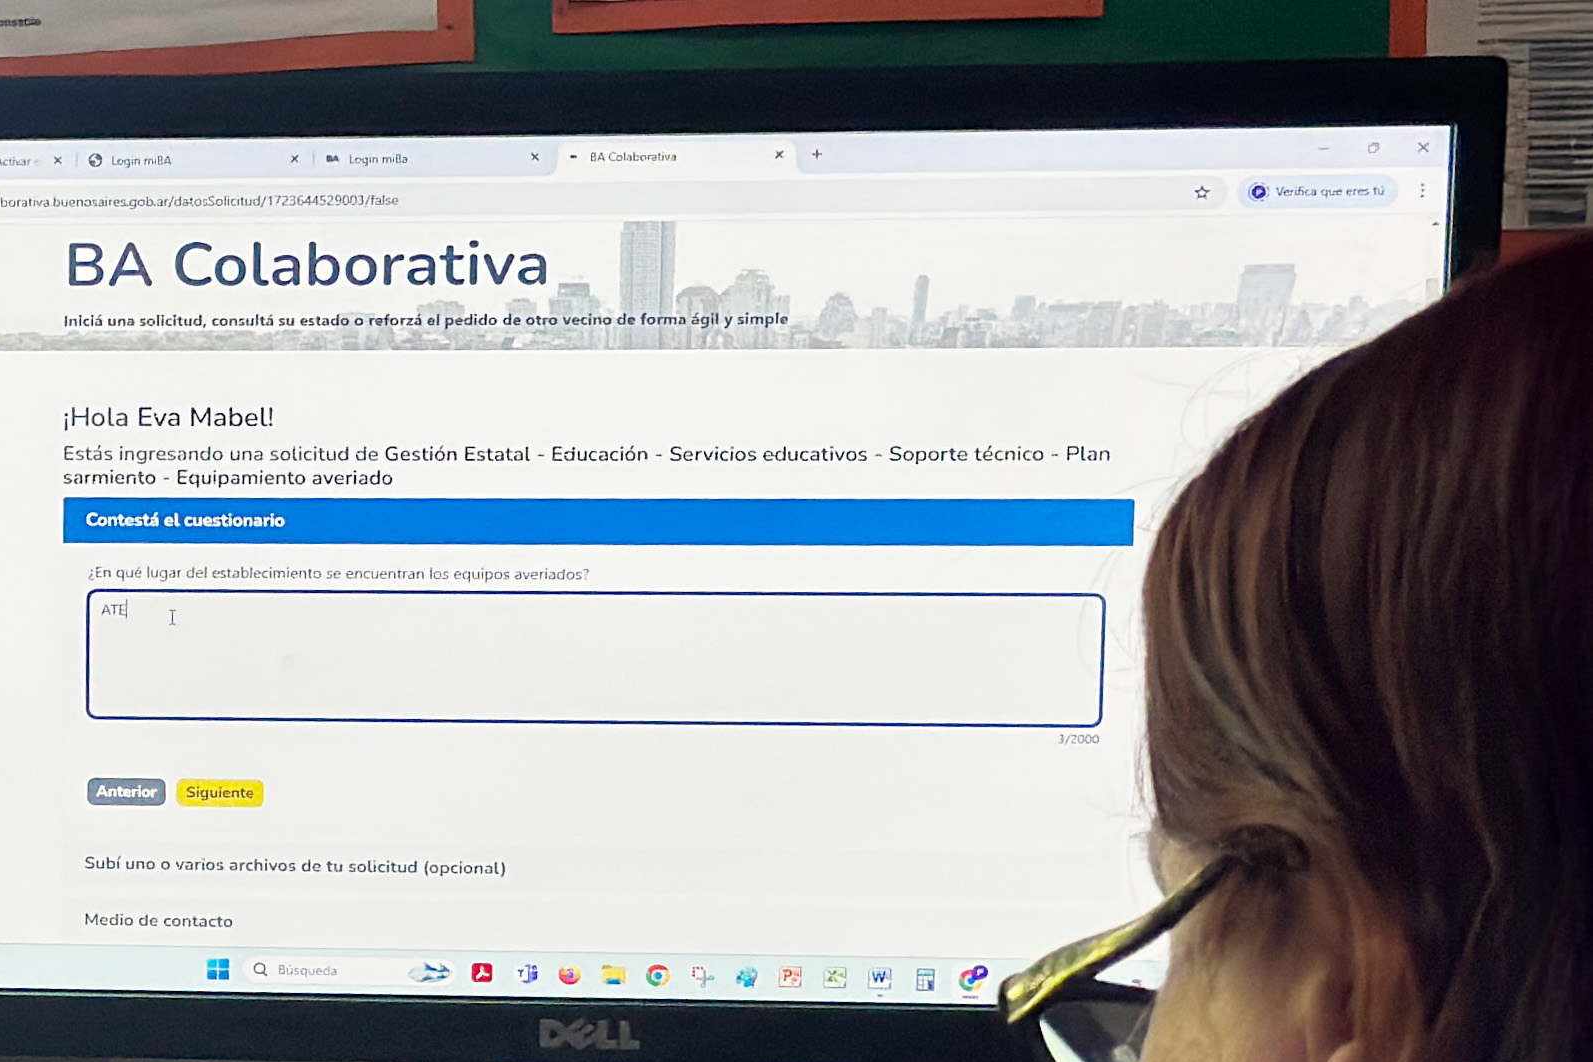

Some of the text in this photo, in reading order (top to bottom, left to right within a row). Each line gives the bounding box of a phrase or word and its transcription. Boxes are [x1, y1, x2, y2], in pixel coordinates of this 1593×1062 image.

[111, 155, 141, 169] Login
[349, 154, 379, 167] Login
[590, 151, 677, 162] BA Colaborativa
[1275, 185, 1318, 197] Verifica
[1320, 188, 1343, 199] que
[1345, 188, 1370, 197] eres
[68, 239, 547, 287] BA Colaborativa
[64, 311, 789, 330] Iniciá una solicitud, consultá su estado o reforzá el pedido de otro vecino de forma ágil y simple
[63, 406, 273, 431] ¡Hola Eva Mabel!
[63, 444, 113, 461] Estás
[119, 445, 224, 465] ingresando
[230, 450, 264, 462] una
[269, 445, 349, 462] solicitud
[355, 446, 379, 462] de
[385, 445, 458, 462] Gestión
[464, 446, 531, 462] Estatal
[551, 444, 649, 462] Educación
[669, 445, 757, 462] Servicios
[762, 445, 868, 462] educativos
[889, 445, 968, 465] Soporte
[974, 444, 1044, 462] técnico
[1066, 445, 1111, 462] Plan
[63, 469, 156, 485] sarmiento
[177, 469, 306, 489] Equipamiento
[312, 469, 393, 486] averiado
[85, 511, 286, 528] Contestá el cuestionario
[88, 566, 590, 584] ¿En qué lugar del establecimiento se encuentran los equipos averiados?
[100, 602, 126, 618] ATE
[95, 784, 254, 802] Anterior Siguiente
[84, 855, 506, 878] Subí uno o varios archivos de tu solicitud (opcional)
[84, 912, 233, 928] Medio de contacto
[278, 964, 338, 979] Búsqueda
[539, 1018, 640, 1050] DELL
